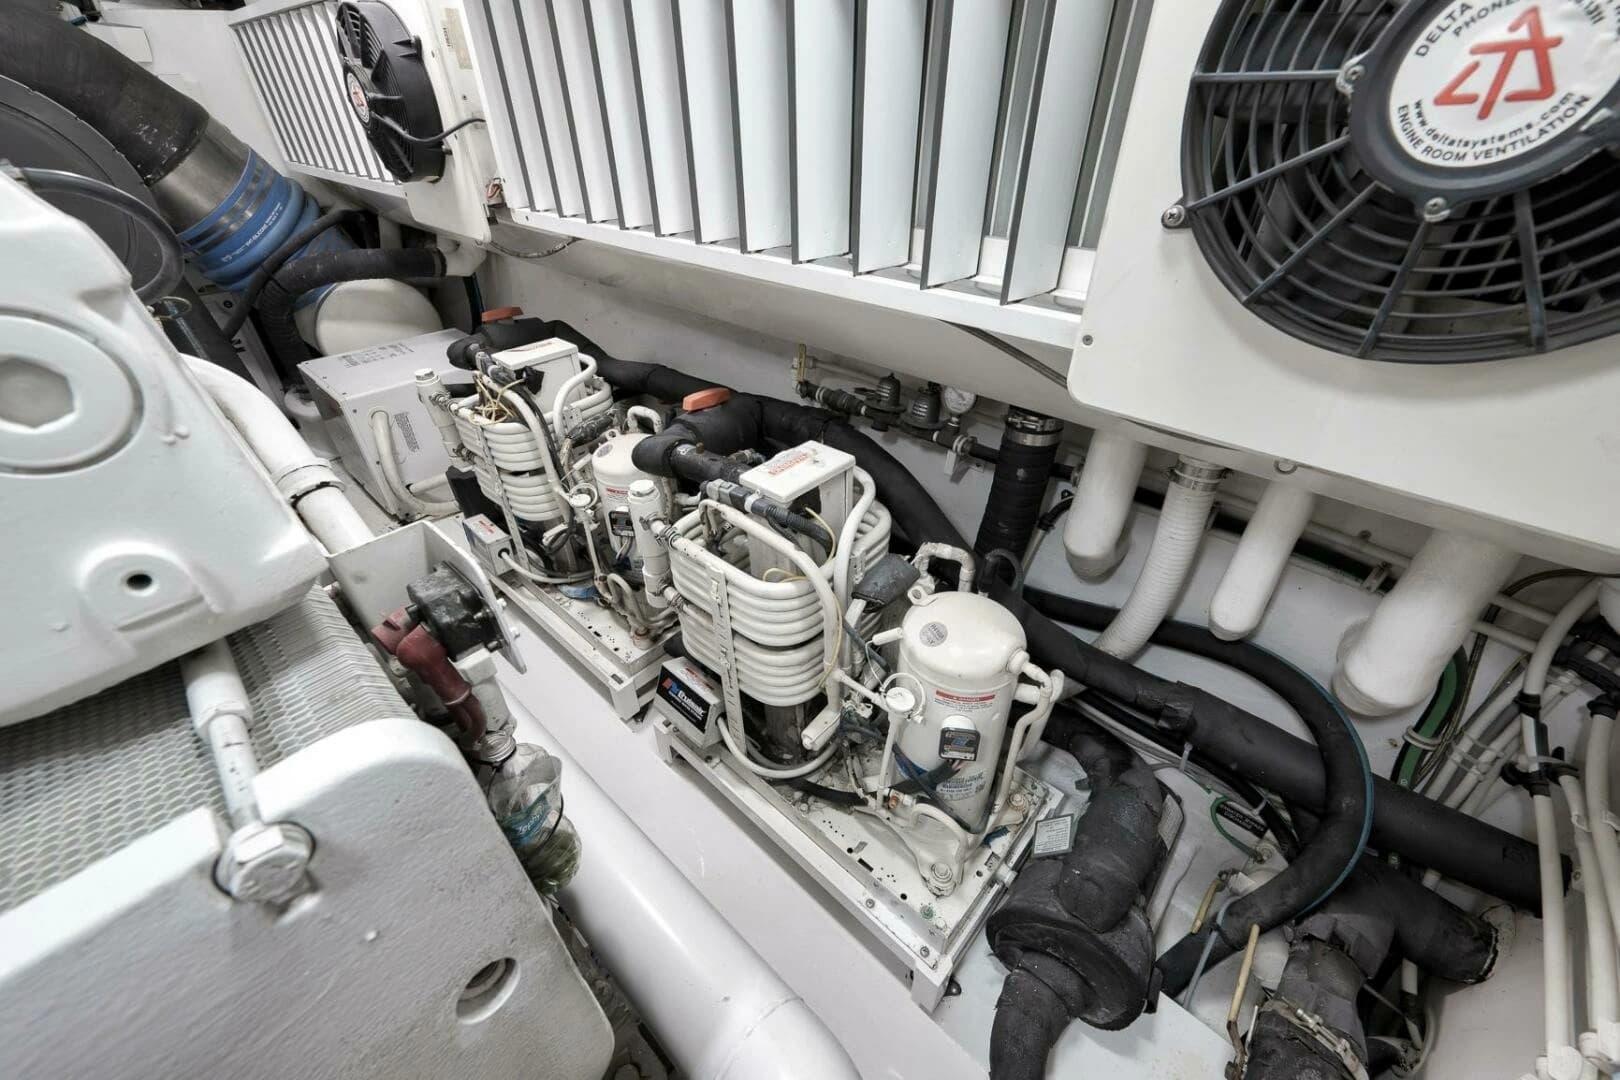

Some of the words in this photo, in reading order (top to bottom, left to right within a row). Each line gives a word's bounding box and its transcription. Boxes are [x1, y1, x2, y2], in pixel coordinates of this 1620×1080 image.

[1415, 2, 1473, 57] DELTA
[1397, 104, 1424, 149] ENGINE
[1421, 145, 1467, 162] ROOM
[1473, 94, 1591, 161] VENTILATION
